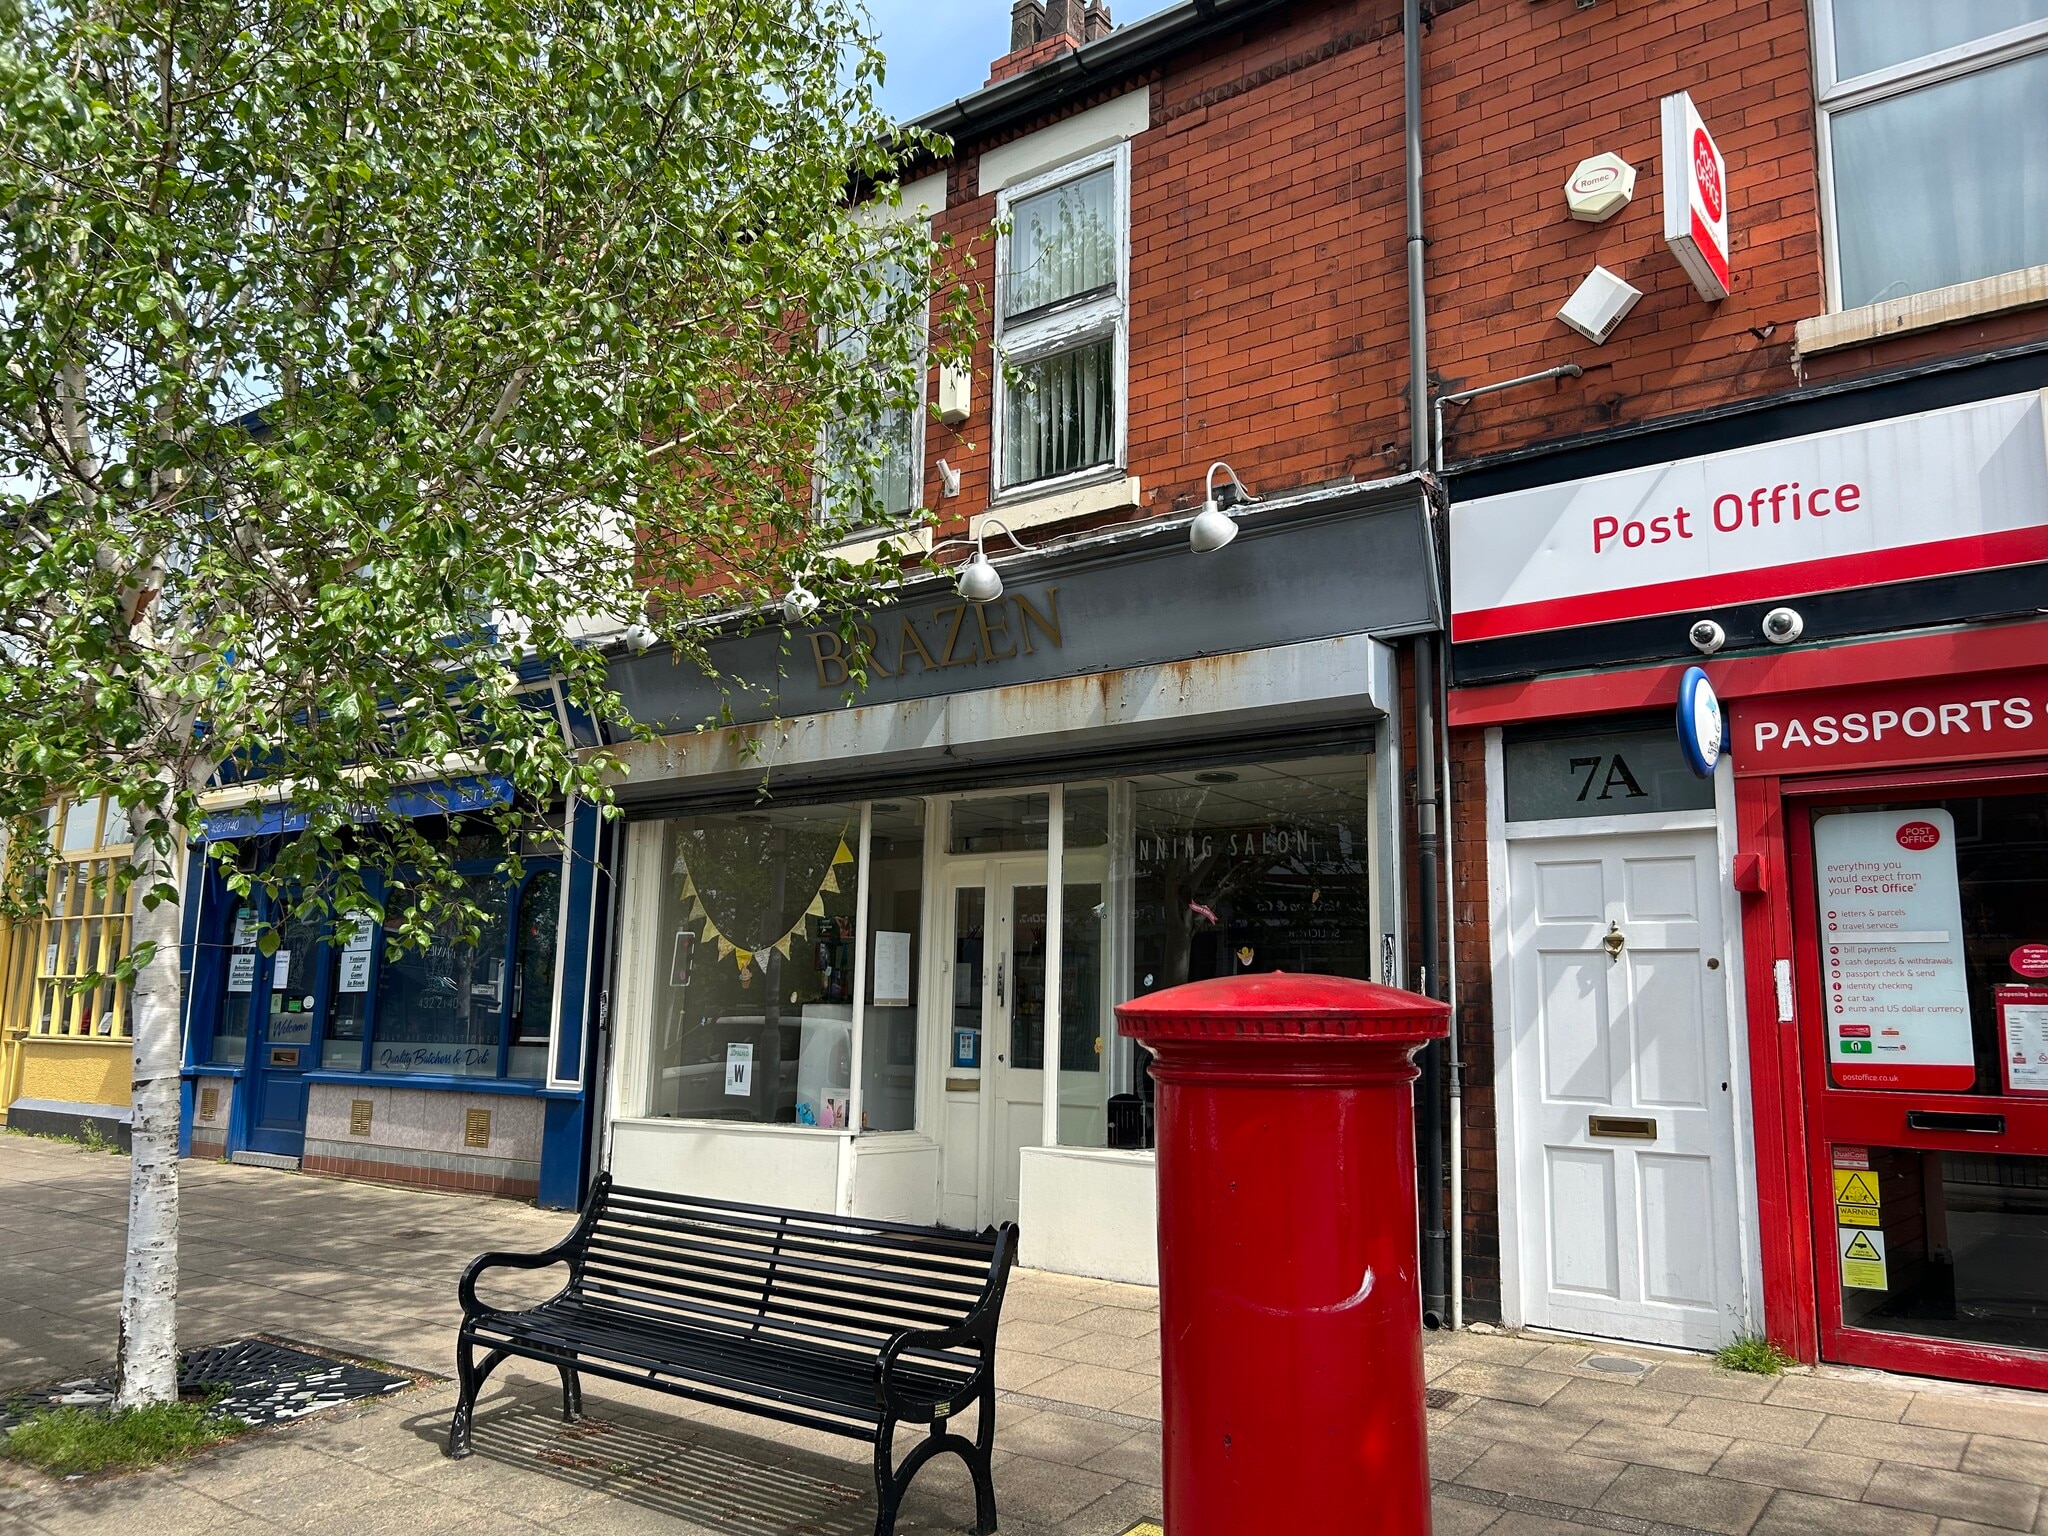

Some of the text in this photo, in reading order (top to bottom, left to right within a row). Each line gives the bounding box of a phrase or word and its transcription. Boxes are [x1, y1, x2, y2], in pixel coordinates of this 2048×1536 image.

[1699, 141, 1717, 184] POST
[1580, 173, 1610, 189] Romec
[1695, 160, 1721, 212] OFFICE
[1593, 482, 1860, 553] Post Office
[805, 587, 1062, 688] BRAZEN
[1754, 697, 2034, 751] PASSPORTS
[1569, 754, 1648, 801] 7A
[1906, 826, 1931, 836] POST
[1230, 830, 1308, 856] SALON
[1900, 835, 1935, 844] OFFICE
[1827, 861, 1902, 873] everything you
[1828, 872, 1922, 884] would expect from
[1829, 887, 1852, 898] your
[1854, 884, 1879, 894] Post
[1841, 908, 1906, 918] letters & parcels
[1858, 946, 1897, 954] payments
[1864, 958, 1896, 966] deposits
[1898, 957, 1905, 965] &
[1906, 957, 1953, 965] withdrawals
[1846, 970, 1880, 978] passport
[1846, 982, 1913, 991] identity checking
[418, 998, 458, 1009] 432 2140
[1928, 1006, 1965, 1014] currency
[272, 1020, 309, 1038] Welcome
[374, 1032, 498, 1044] FULLY AIR CONDITIONED
[381, 1048, 490, 1070] Quality Butchers & Deli
[734, 1064, 744, 1083] W
[1842, 1074, 1899, 1082] postoffice.co.uk
[1840, 1208, 1878, 1216] WARNING
